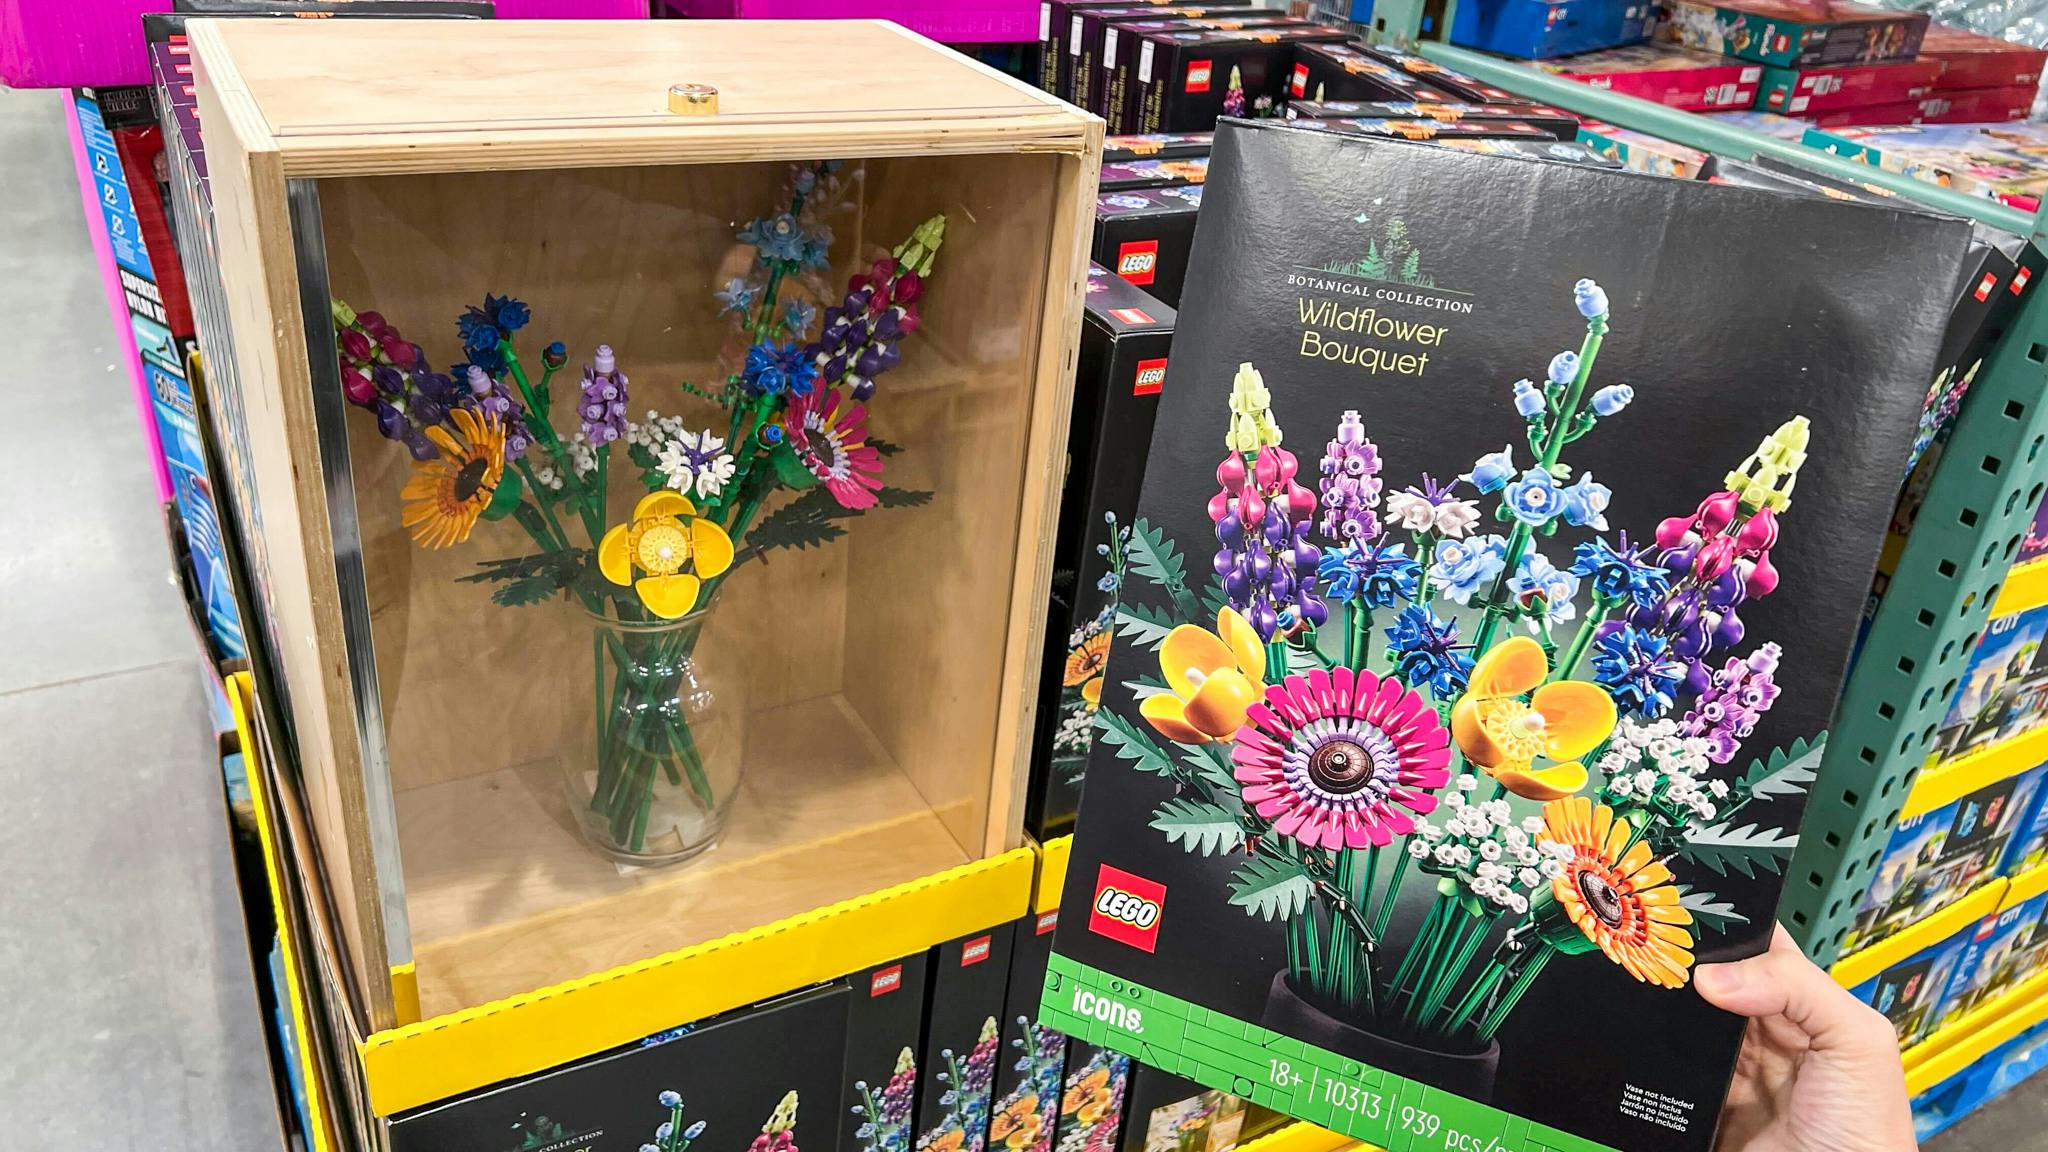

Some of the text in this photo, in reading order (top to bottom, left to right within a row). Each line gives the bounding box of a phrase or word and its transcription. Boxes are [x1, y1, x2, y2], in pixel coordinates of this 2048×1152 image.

[1119, 253, 1156, 274] LEGO
[1287, 274, 1474, 314] BOTANICAL COLLECTION
[1298, 297, 1448, 347] Wildflower
[1300, 330, 1430, 376] Bouquet
[1137, 368, 1165, 385] LEGO
[1095, 886, 1160, 930] LEGO
[1269, 1059, 1303, 1088] 18+
[1324, 1078, 1381, 1119] 10313
[1401, 1105, 1440, 1139] 939
[1623, 1090, 1682, 1115] Vase non inclus
[1625, 1083, 1694, 1110] Vase not included
[1619, 1105, 1686, 1132] Vaso não incluído
[1620, 1098, 1689, 1125] Jarrón no incluido
[539, 1129, 604, 1152] COLLECTION
